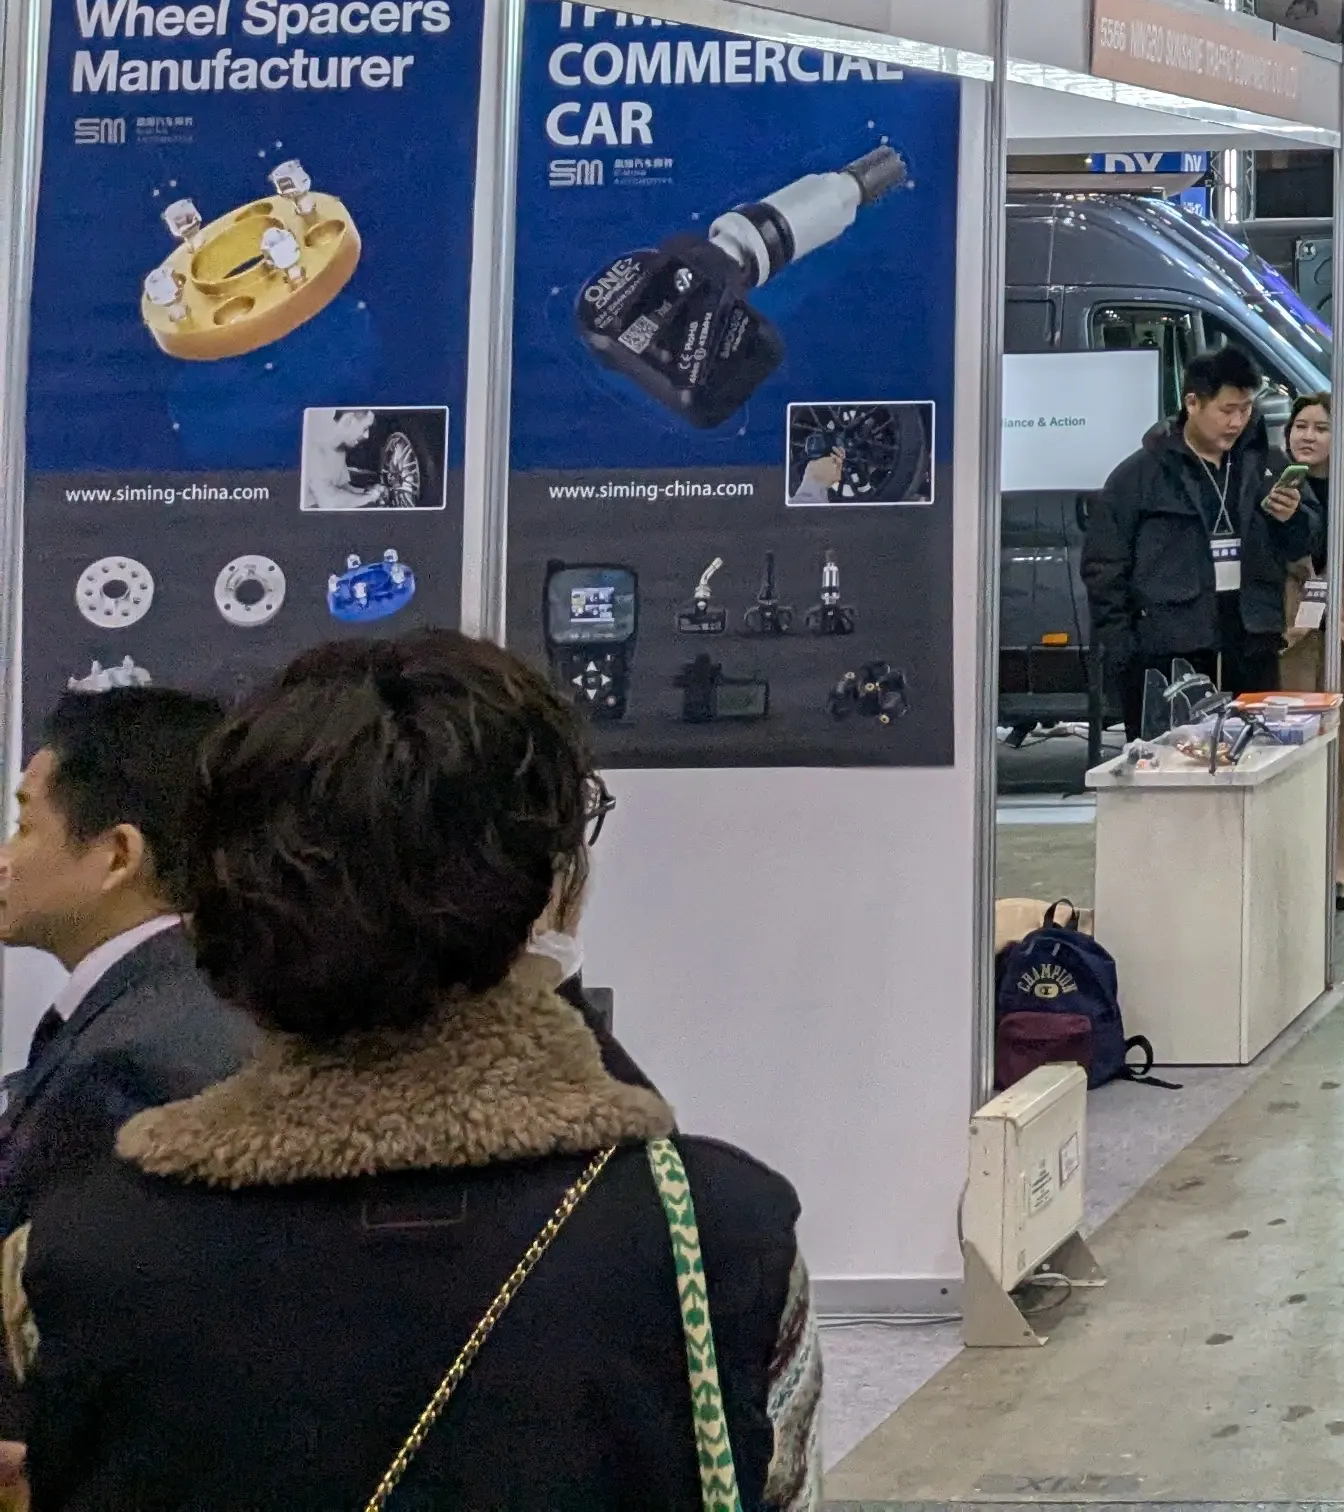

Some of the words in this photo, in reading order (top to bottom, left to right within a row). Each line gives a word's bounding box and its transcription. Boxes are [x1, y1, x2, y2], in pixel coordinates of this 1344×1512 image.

[72, 47, 415, 94] Manufacturer
[545, 100, 654, 146] CAR
[1037, 416, 1047, 427] &
[1049, 415, 1087, 427] Action
[65, 482, 270, 505] www.siming-china.com
[548, 478, 755, 502] www.siming-china.com
[1017, 963, 1078, 994] CHAMPION
